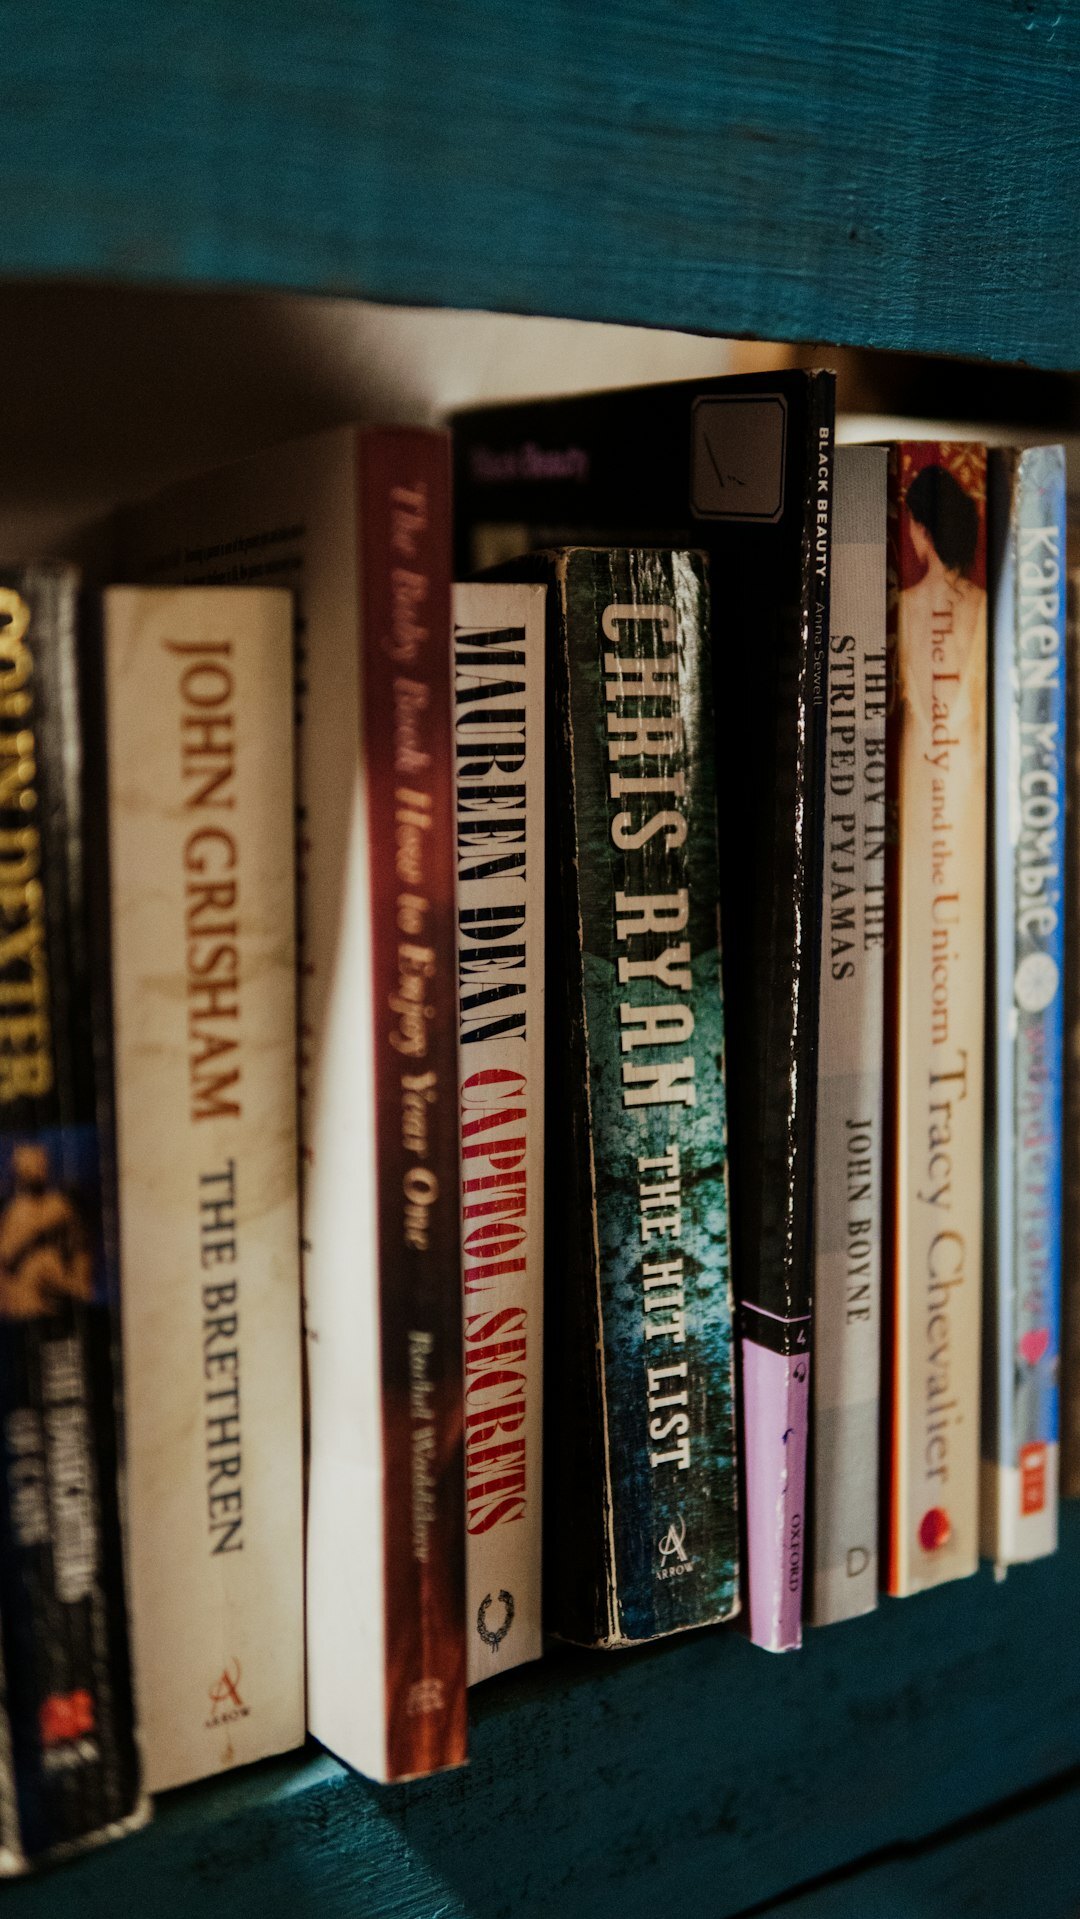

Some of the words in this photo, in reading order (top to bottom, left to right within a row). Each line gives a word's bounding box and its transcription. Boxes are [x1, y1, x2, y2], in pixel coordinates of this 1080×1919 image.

[817, 427, 829, 492] BLACK
[815, 499, 828, 577] BEAUTY
[813, 602, 826, 644] Anna
[932, 601, 955, 662] The
[161, 638, 236, 812] JOHN
[601, 602, 689, 851] CHRIS
[811, 650, 825, 707] Sewell
[829, 634, 857, 797] STRIPED
[863, 645, 888, 720] THE
[924, 671, 960, 772] Lady
[454, 625, 528, 881] MAUREEN
[863, 736, 888, 803] BOY
[863, 824, 888, 861] IN
[932, 779, 954, 830] and
[830, 813, 856, 982] PYJAMAS
[932, 841, 953, 885] the
[863, 883, 887, 951] THE
[181, 824, 242, 1123] GRISHAM
[457, 902, 528, 1044] DEAN
[613, 887, 697, 1111] RYAN
[931, 892, 960, 1046] Unicorn
[400, 1069, 439, 1159] Year
[846, 1119, 873, 1202] JOHN
[917, 1049, 967, 1210] Tracy
[198, 1158, 238, 1276] THE
[401, 1166, 439, 1251] One
[460, 1068, 528, 1296] CAPITOL
[639, 1144, 682, 1242] THE
[642, 1257, 686, 1344] HIT
[846, 1219, 873, 1327] BOYNE
[924, 1230, 964, 1485] Chevalier
[201, 1283, 244, 1558] BRETHREN
[464, 1306, 529, 1537] SECRETS
[647, 1361, 691, 1472] LIST
[655, 1561, 696, 1581] ARROW
[787, 1514, 802, 1593] OXFORD
